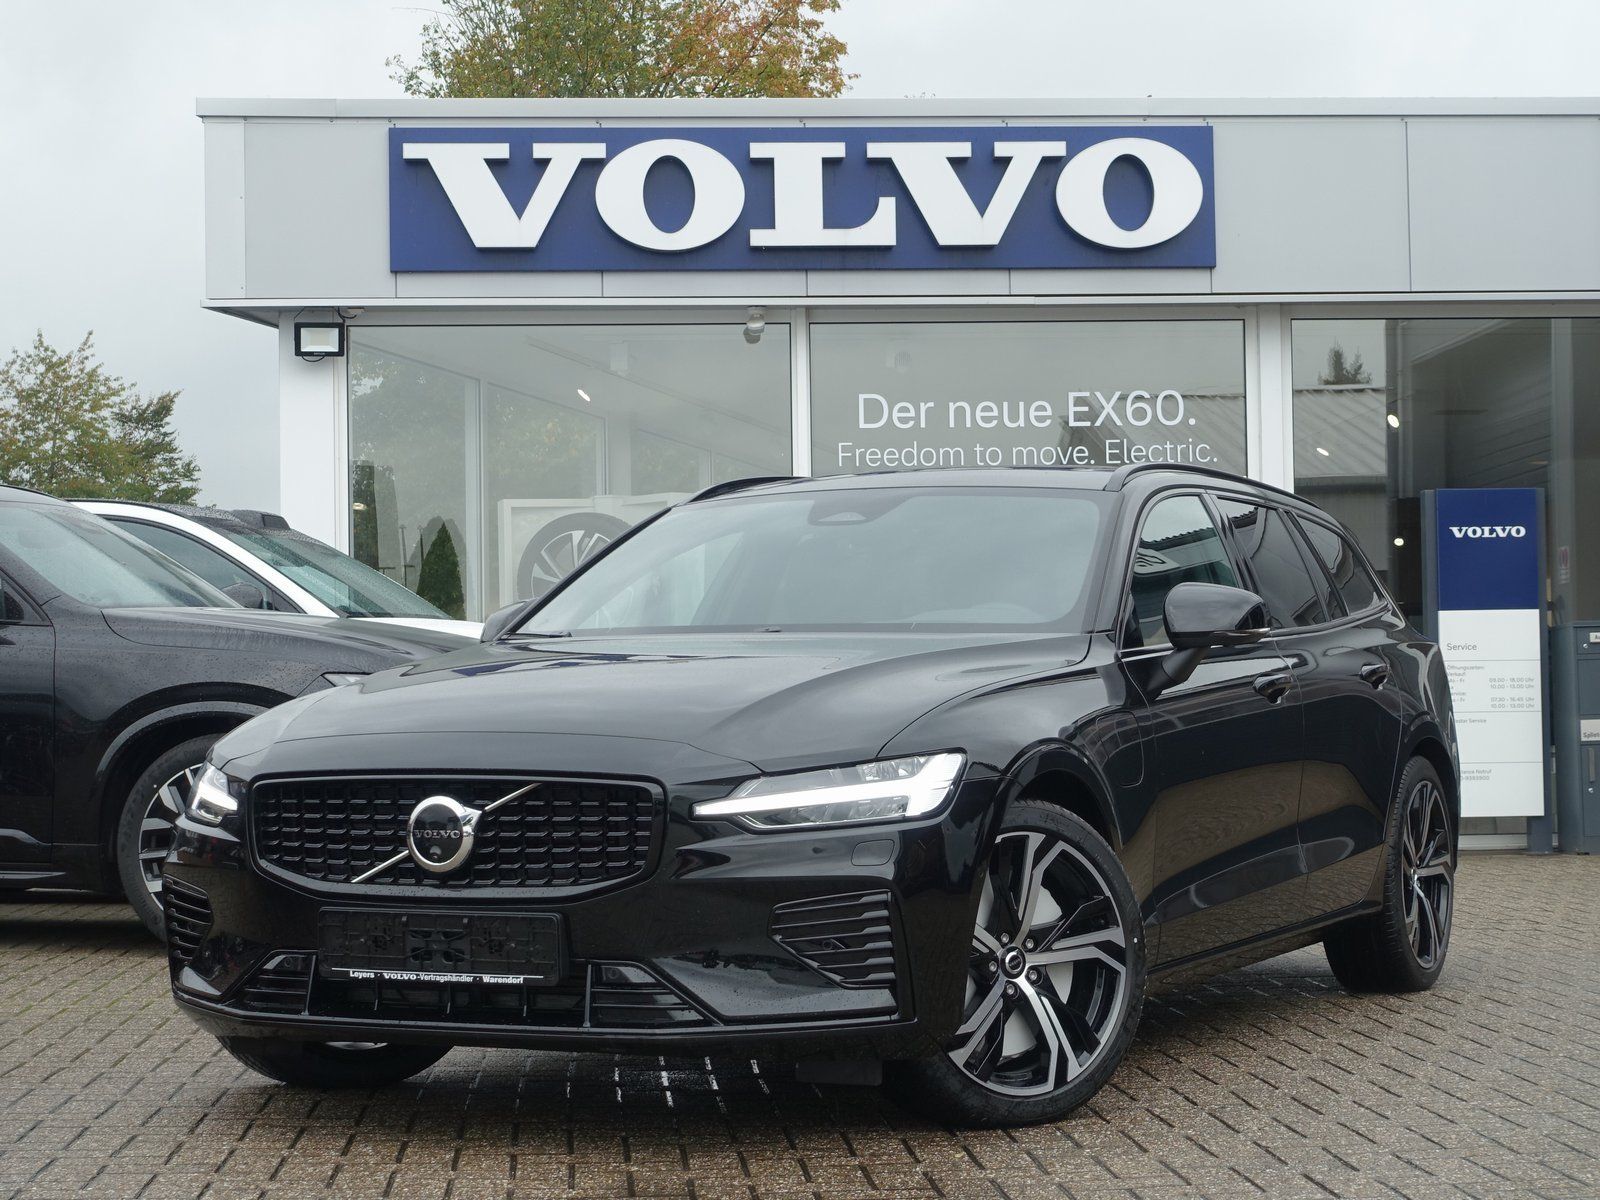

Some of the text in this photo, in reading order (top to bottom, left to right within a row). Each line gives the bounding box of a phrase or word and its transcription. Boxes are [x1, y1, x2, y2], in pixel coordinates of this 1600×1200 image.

[403, 137, 1203, 251] VOLVO
[857, 389, 1196, 429] Der neue EX60.
[838, 438, 1218, 467] Freedom to move. Electric.
[1449, 526, 1526, 538] VOLVO
[1446, 643, 1477, 651] Service
[413, 829, 461, 838] VOLVO
[349, 970, 375, 979] Leyers
[482, 976, 524, 984] Warendorf
